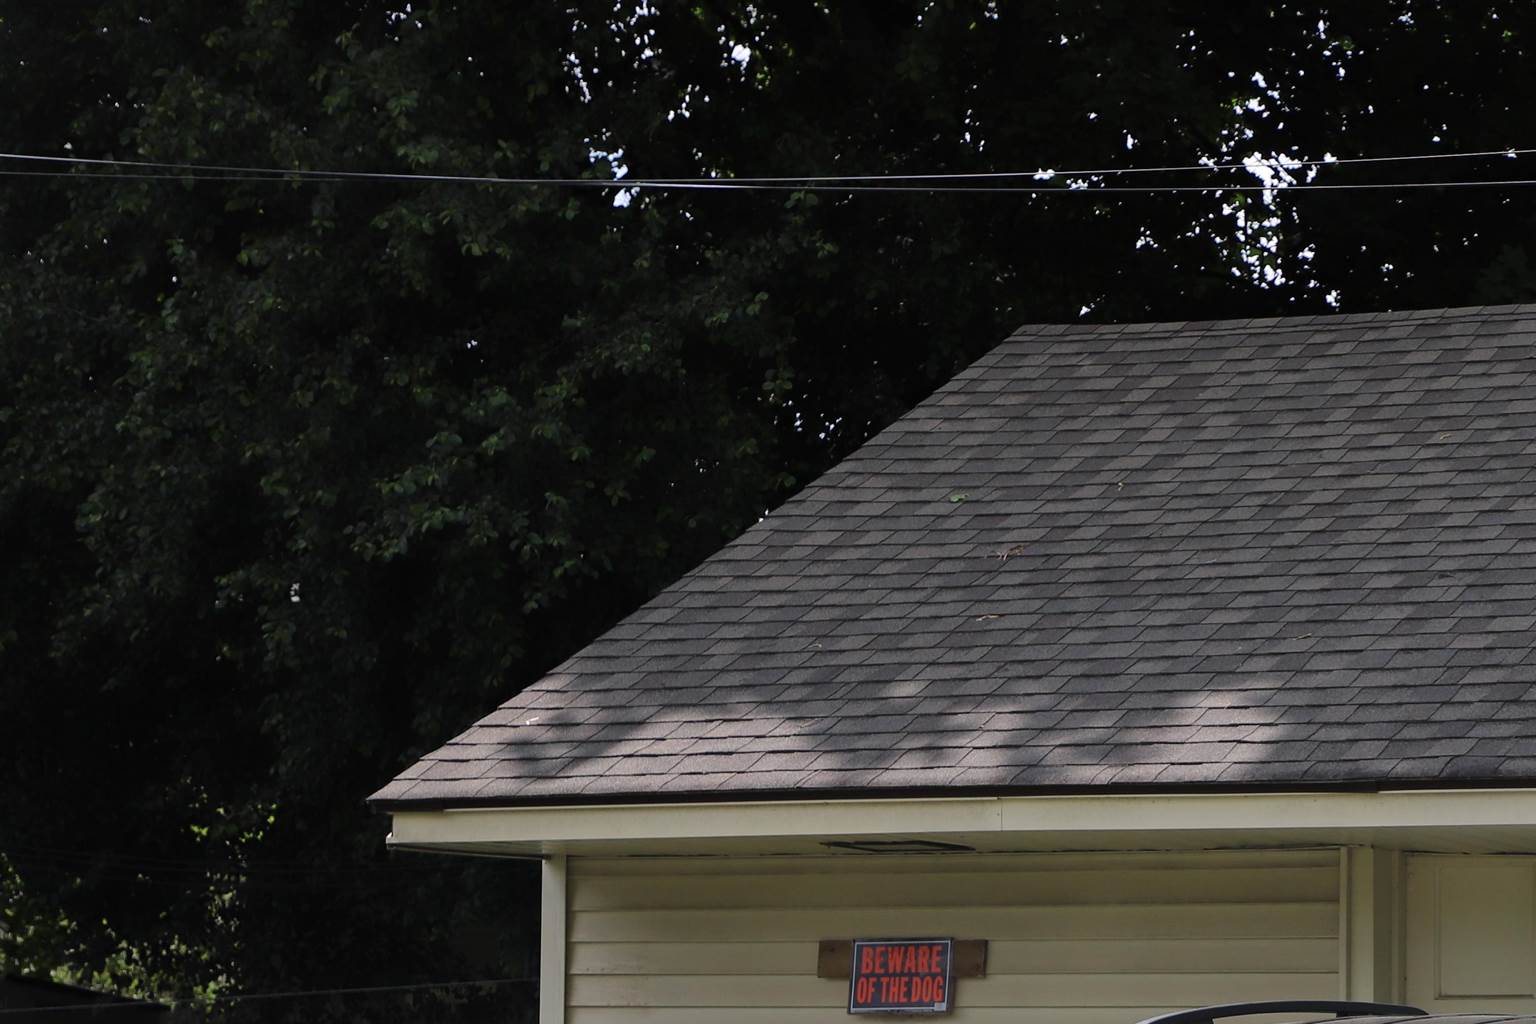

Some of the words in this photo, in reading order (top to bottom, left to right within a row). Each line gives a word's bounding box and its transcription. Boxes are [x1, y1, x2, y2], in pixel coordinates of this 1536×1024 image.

[861, 945, 943, 974] BEWARE
[856, 977, 877, 1004] OF
[880, 977, 909, 1003] THE
[911, 976, 944, 1002] DOG
